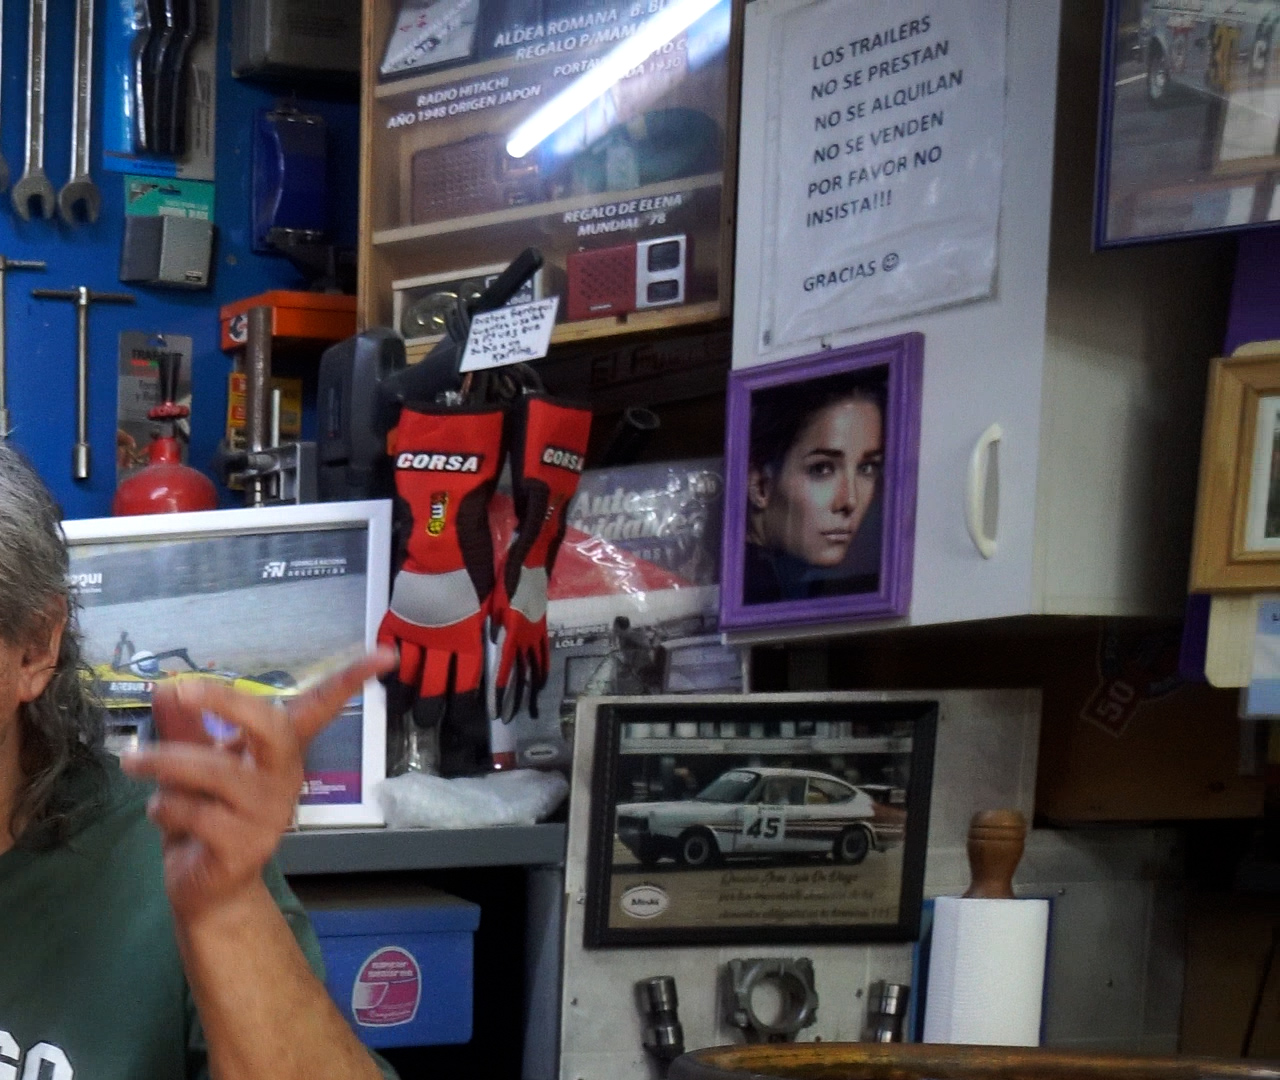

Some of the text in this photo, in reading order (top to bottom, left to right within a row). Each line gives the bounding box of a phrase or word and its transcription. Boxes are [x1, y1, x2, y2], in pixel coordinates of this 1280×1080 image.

[494, 25, 544, 48] ALDEA
[546, 8, 617, 36] ROMANA
[812, 16, 931, 70] LOS TRAILERS
[515, 36, 576, 60] REGALO
[811, 40, 949, 100] NO SE PRESTAN
[387, 112, 415, 129] AÑO
[449, 95, 497, 116] ORIGEN
[498, 85, 542, 106] JAPON
[417, 77, 509, 107] RADIO HITACHI
[814, 70, 963, 132] NO SE ALQUILAN
[814, 111, 944, 164] NO SE VENDEN
[807, 146, 942, 199] POR FAVOR NO
[563, 194, 682, 224] REGALO DE ELENA
[806, 189, 892, 228] INSISTA!!!
[577, 219, 638, 237] MUNDIAL
[803, 261, 876, 292] GRACIAS
[396, 453, 479, 473] CORSA
[542, 448, 585, 473] CORSA
[746, 817, 780, 839] 45
